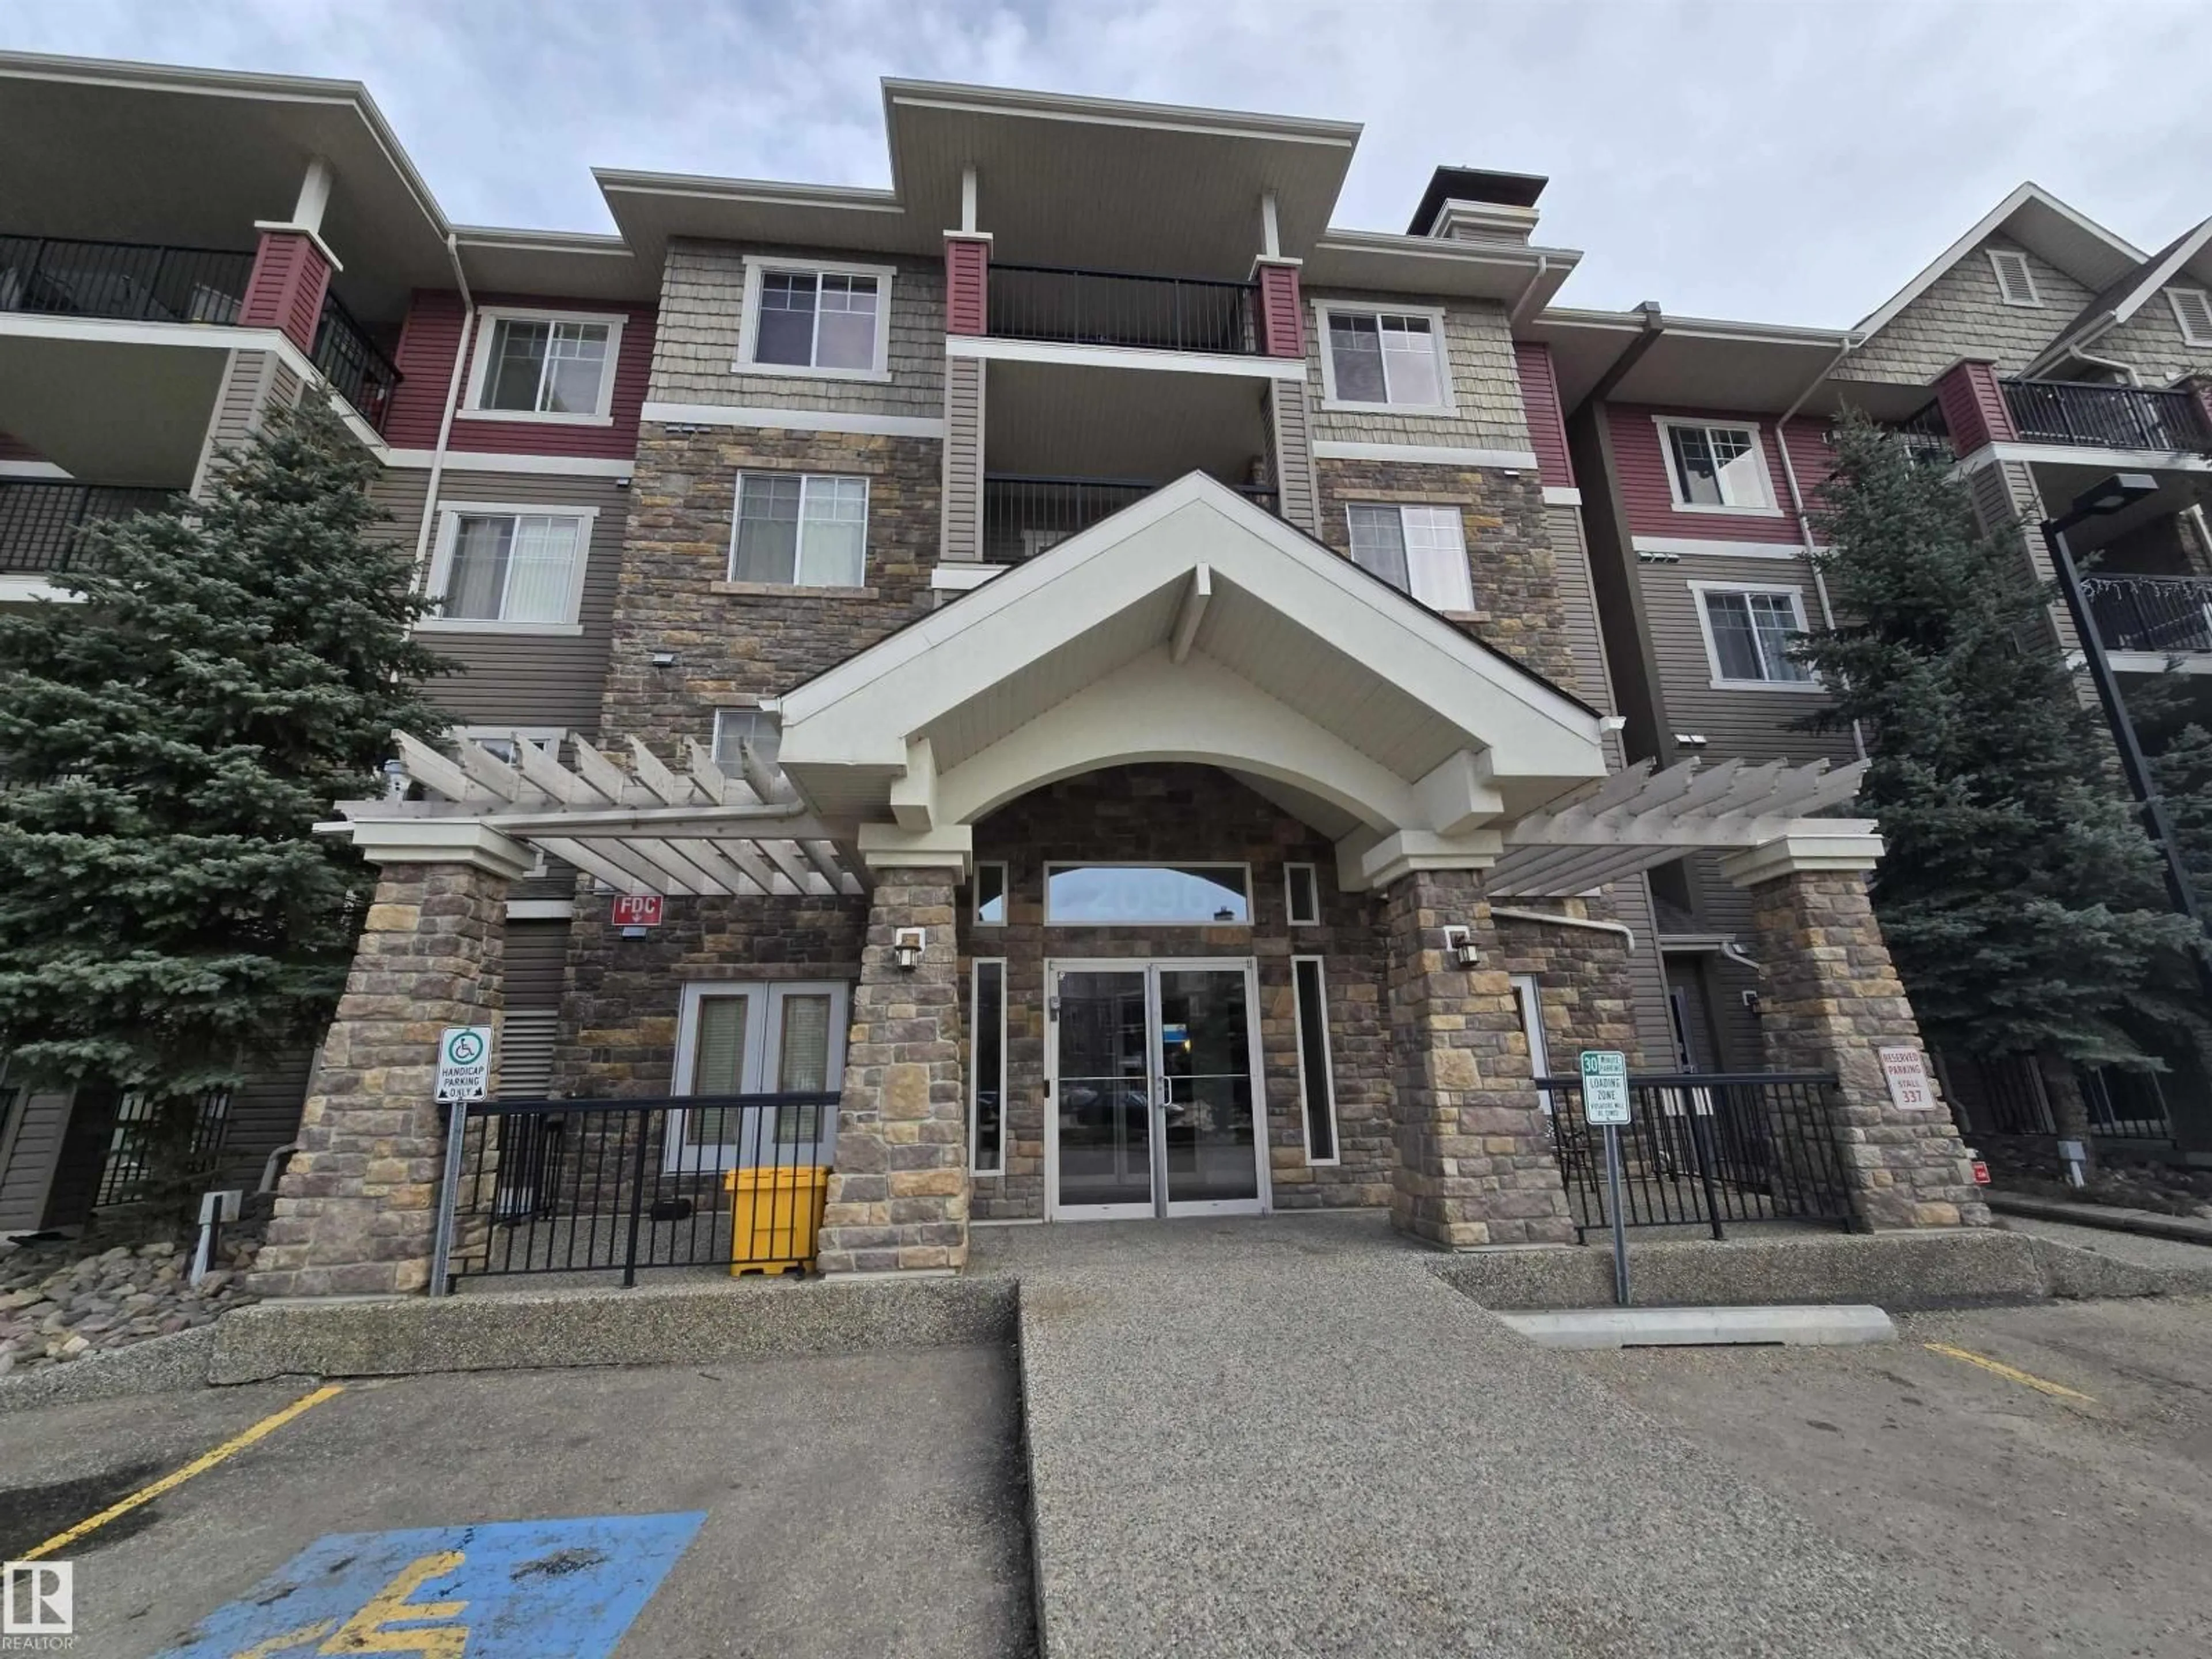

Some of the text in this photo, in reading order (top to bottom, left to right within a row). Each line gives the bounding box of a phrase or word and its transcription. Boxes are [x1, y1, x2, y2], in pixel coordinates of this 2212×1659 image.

[1089, 879, 1209, 914] 2096
[620, 897, 657, 914] FDC
[1882, 1052, 1918, 1062] RESERVED
[1584, 1057, 1597, 1072] 30
[1888, 1065, 1921, 1074] PARKING
[442, 1066, 484, 1076] HANDICAP
[444, 1077, 479, 1086] PARKING
[1590, 1078, 1620, 1088] LOADING
[450, 1088, 471, 1097] ONLY
[1598, 1091, 1615, 1100] ZONE
[1902, 1090, 1923, 1103] 337
